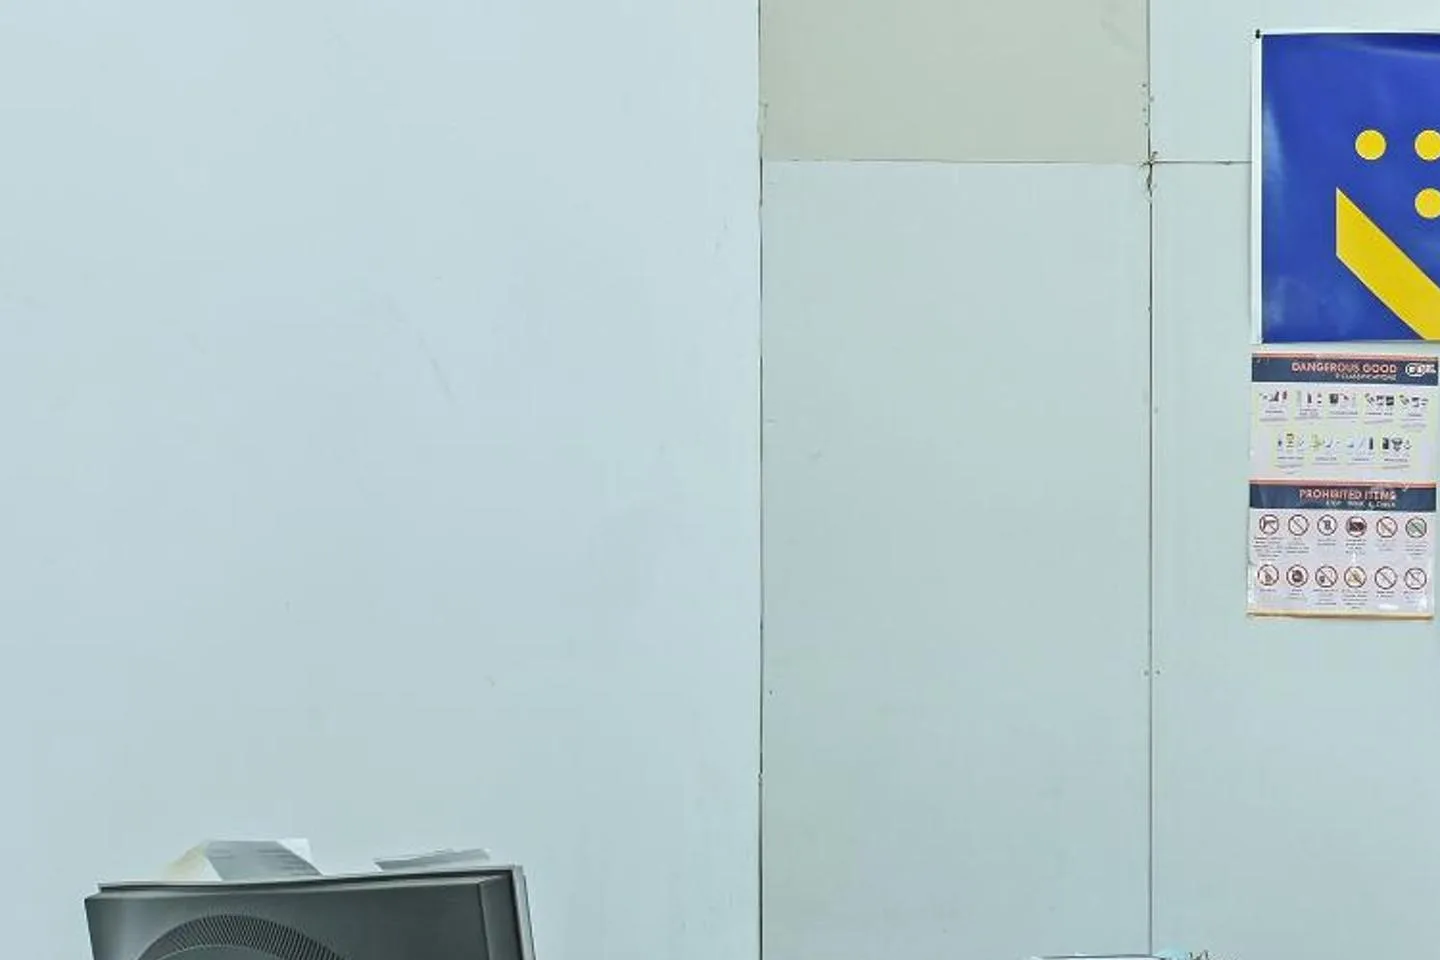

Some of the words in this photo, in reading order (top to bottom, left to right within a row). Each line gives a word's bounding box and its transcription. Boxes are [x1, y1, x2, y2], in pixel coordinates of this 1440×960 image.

[1291, 362, 1360, 374] DANGEROUS
[1362, 363, 1398, 375] GOOD
[1300, 488, 1363, 501] PROHIBITED
[1364, 489, 1397, 502] ITEMS
